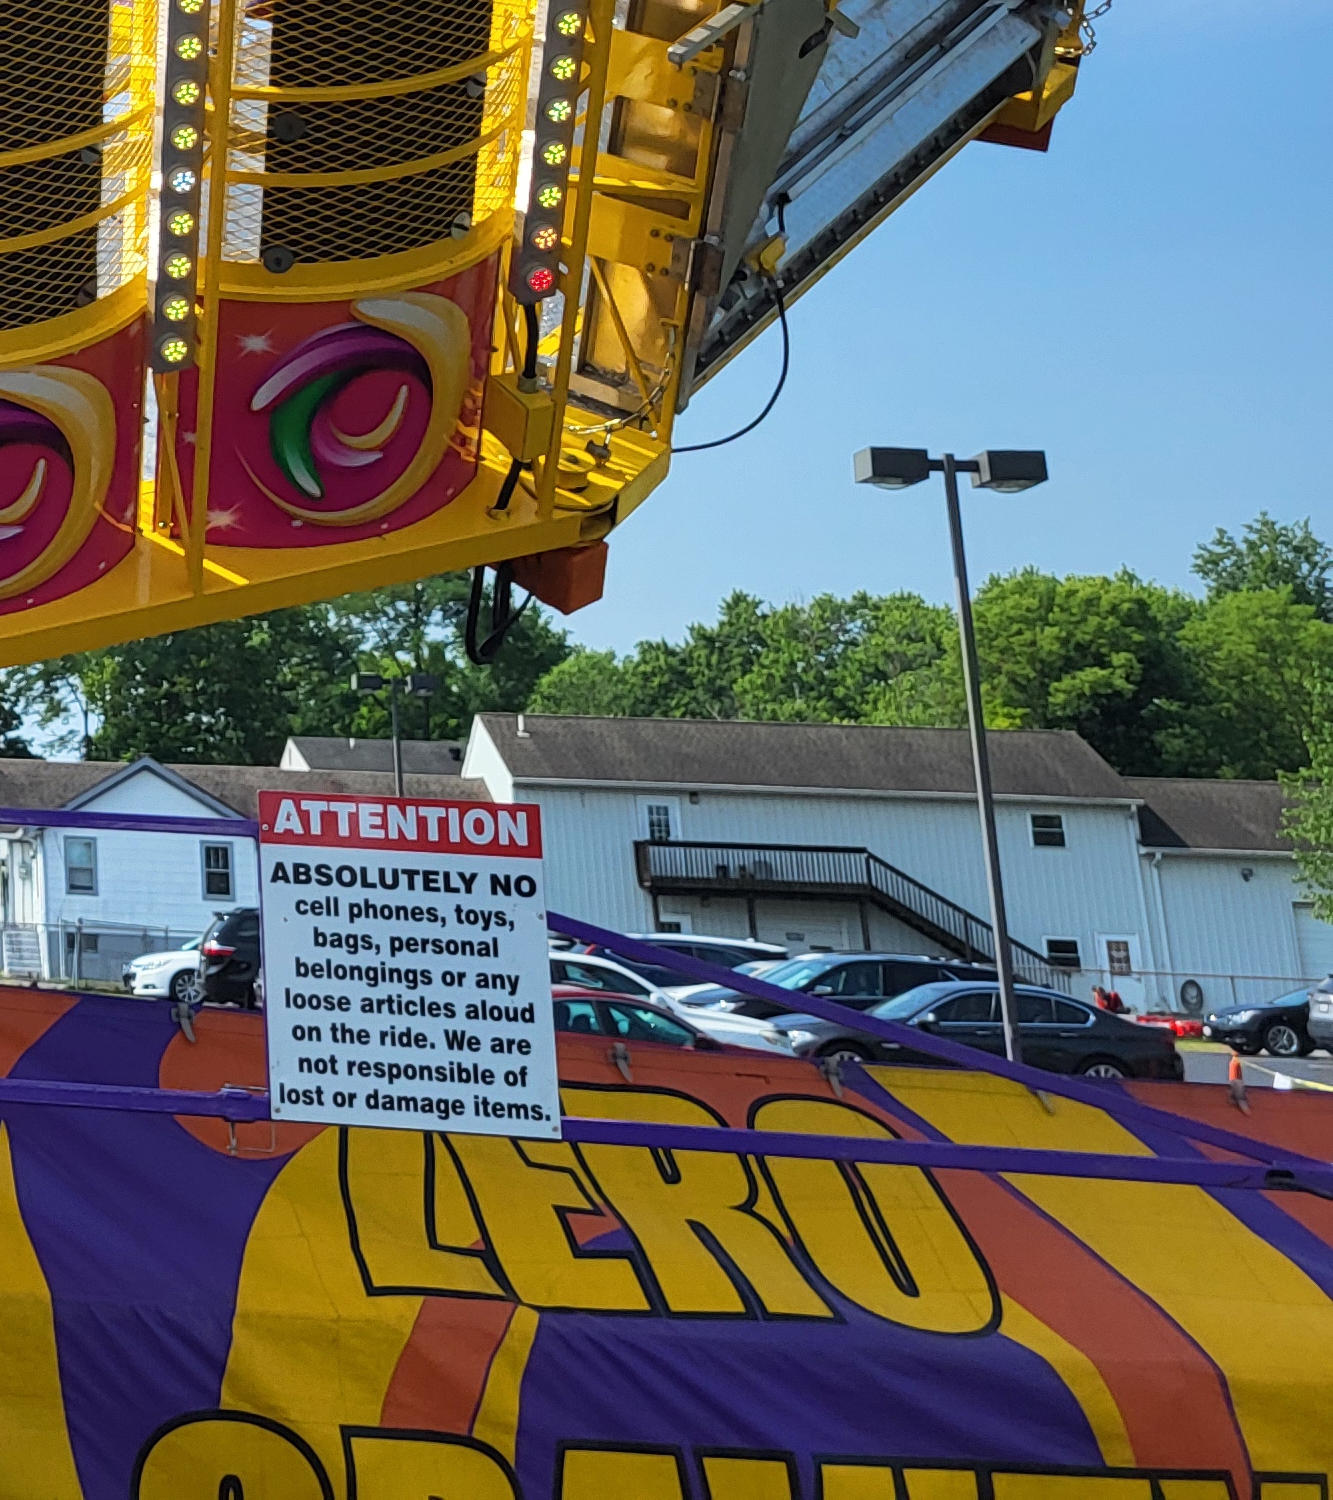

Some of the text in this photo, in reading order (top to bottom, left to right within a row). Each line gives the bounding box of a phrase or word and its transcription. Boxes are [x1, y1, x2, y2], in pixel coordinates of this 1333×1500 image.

[273, 798, 529, 847] ATTENTION
[270, 861, 537, 898] ABSOLUTELY NO
[294, 896, 515, 931] cell phones, toys,
[313, 926, 499, 958] bags, personal
[295, 956, 520, 996] belongings or any
[284, 987, 535, 1024] loose articles aloud
[291, 1022, 531, 1055] on the ride. We are
[298, 1054, 528, 1088] not responsible of
[279, 1082, 552, 1122] lost or damage items.
